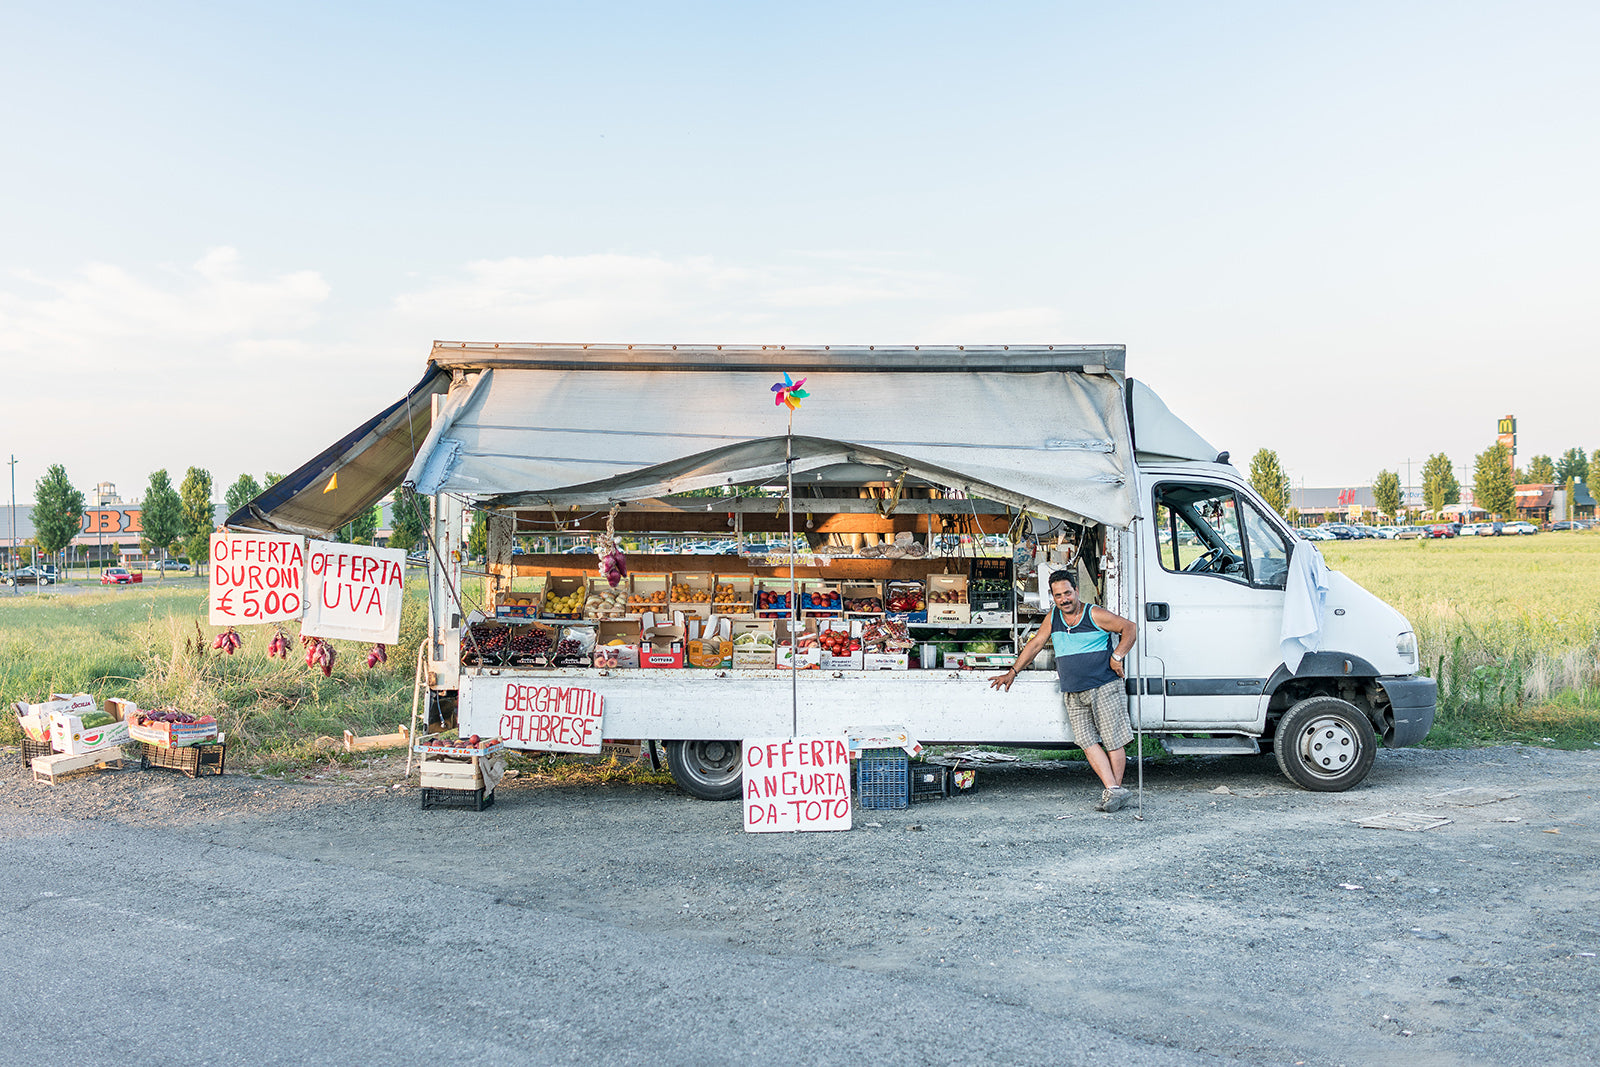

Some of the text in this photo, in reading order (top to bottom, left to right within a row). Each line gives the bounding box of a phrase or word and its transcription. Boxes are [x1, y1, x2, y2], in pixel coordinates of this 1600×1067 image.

[214, 540, 304, 567] OFFERTA
[216, 564, 299, 590] DURONI
[311, 552, 403, 589] OFFERTA
[243, 589, 300, 620] 5,00
[323, 580, 383, 616] UVA
[499, 714, 595, 747] CALABRESE
[747, 740, 848, 768] OFFERTA
